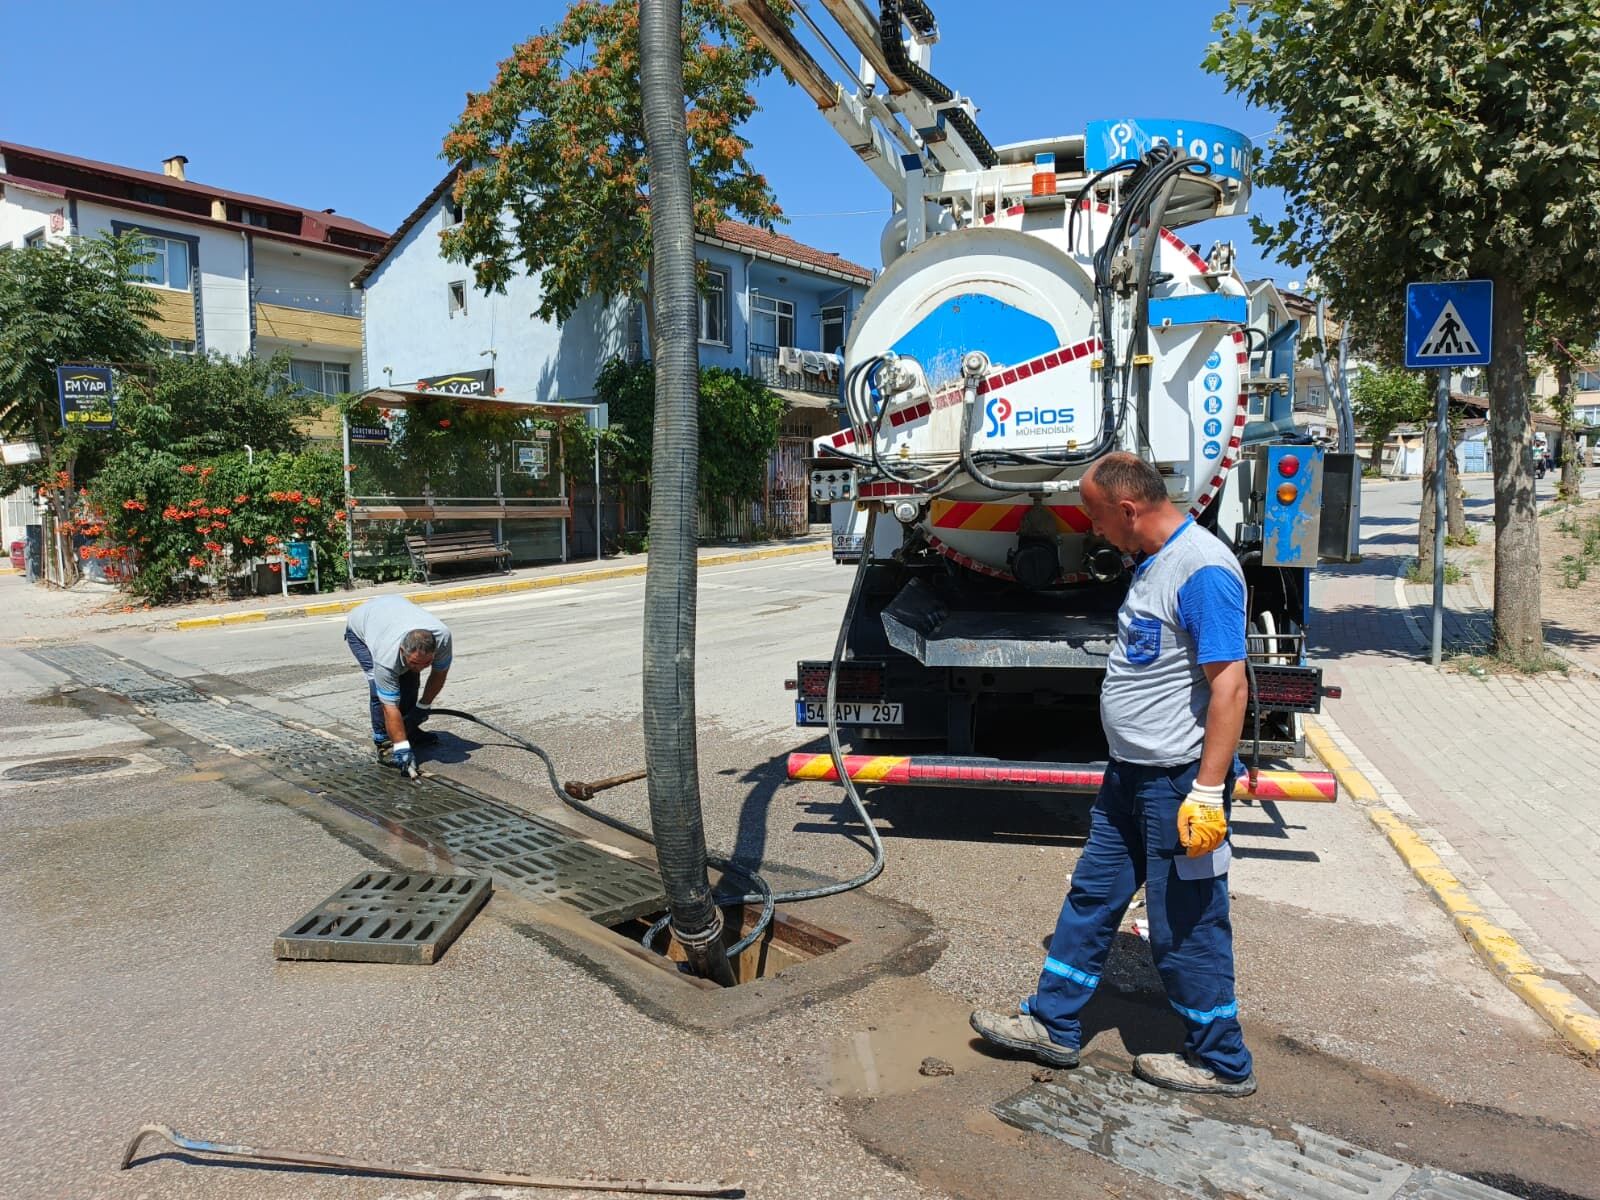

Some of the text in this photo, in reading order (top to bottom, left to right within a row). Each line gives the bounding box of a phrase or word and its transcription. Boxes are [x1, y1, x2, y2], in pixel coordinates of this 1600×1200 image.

[65, 380, 81, 392] FM
[449, 381, 485, 394] YAPI
[807, 703, 825, 721] 54
[872, 705, 900, 722] 297
